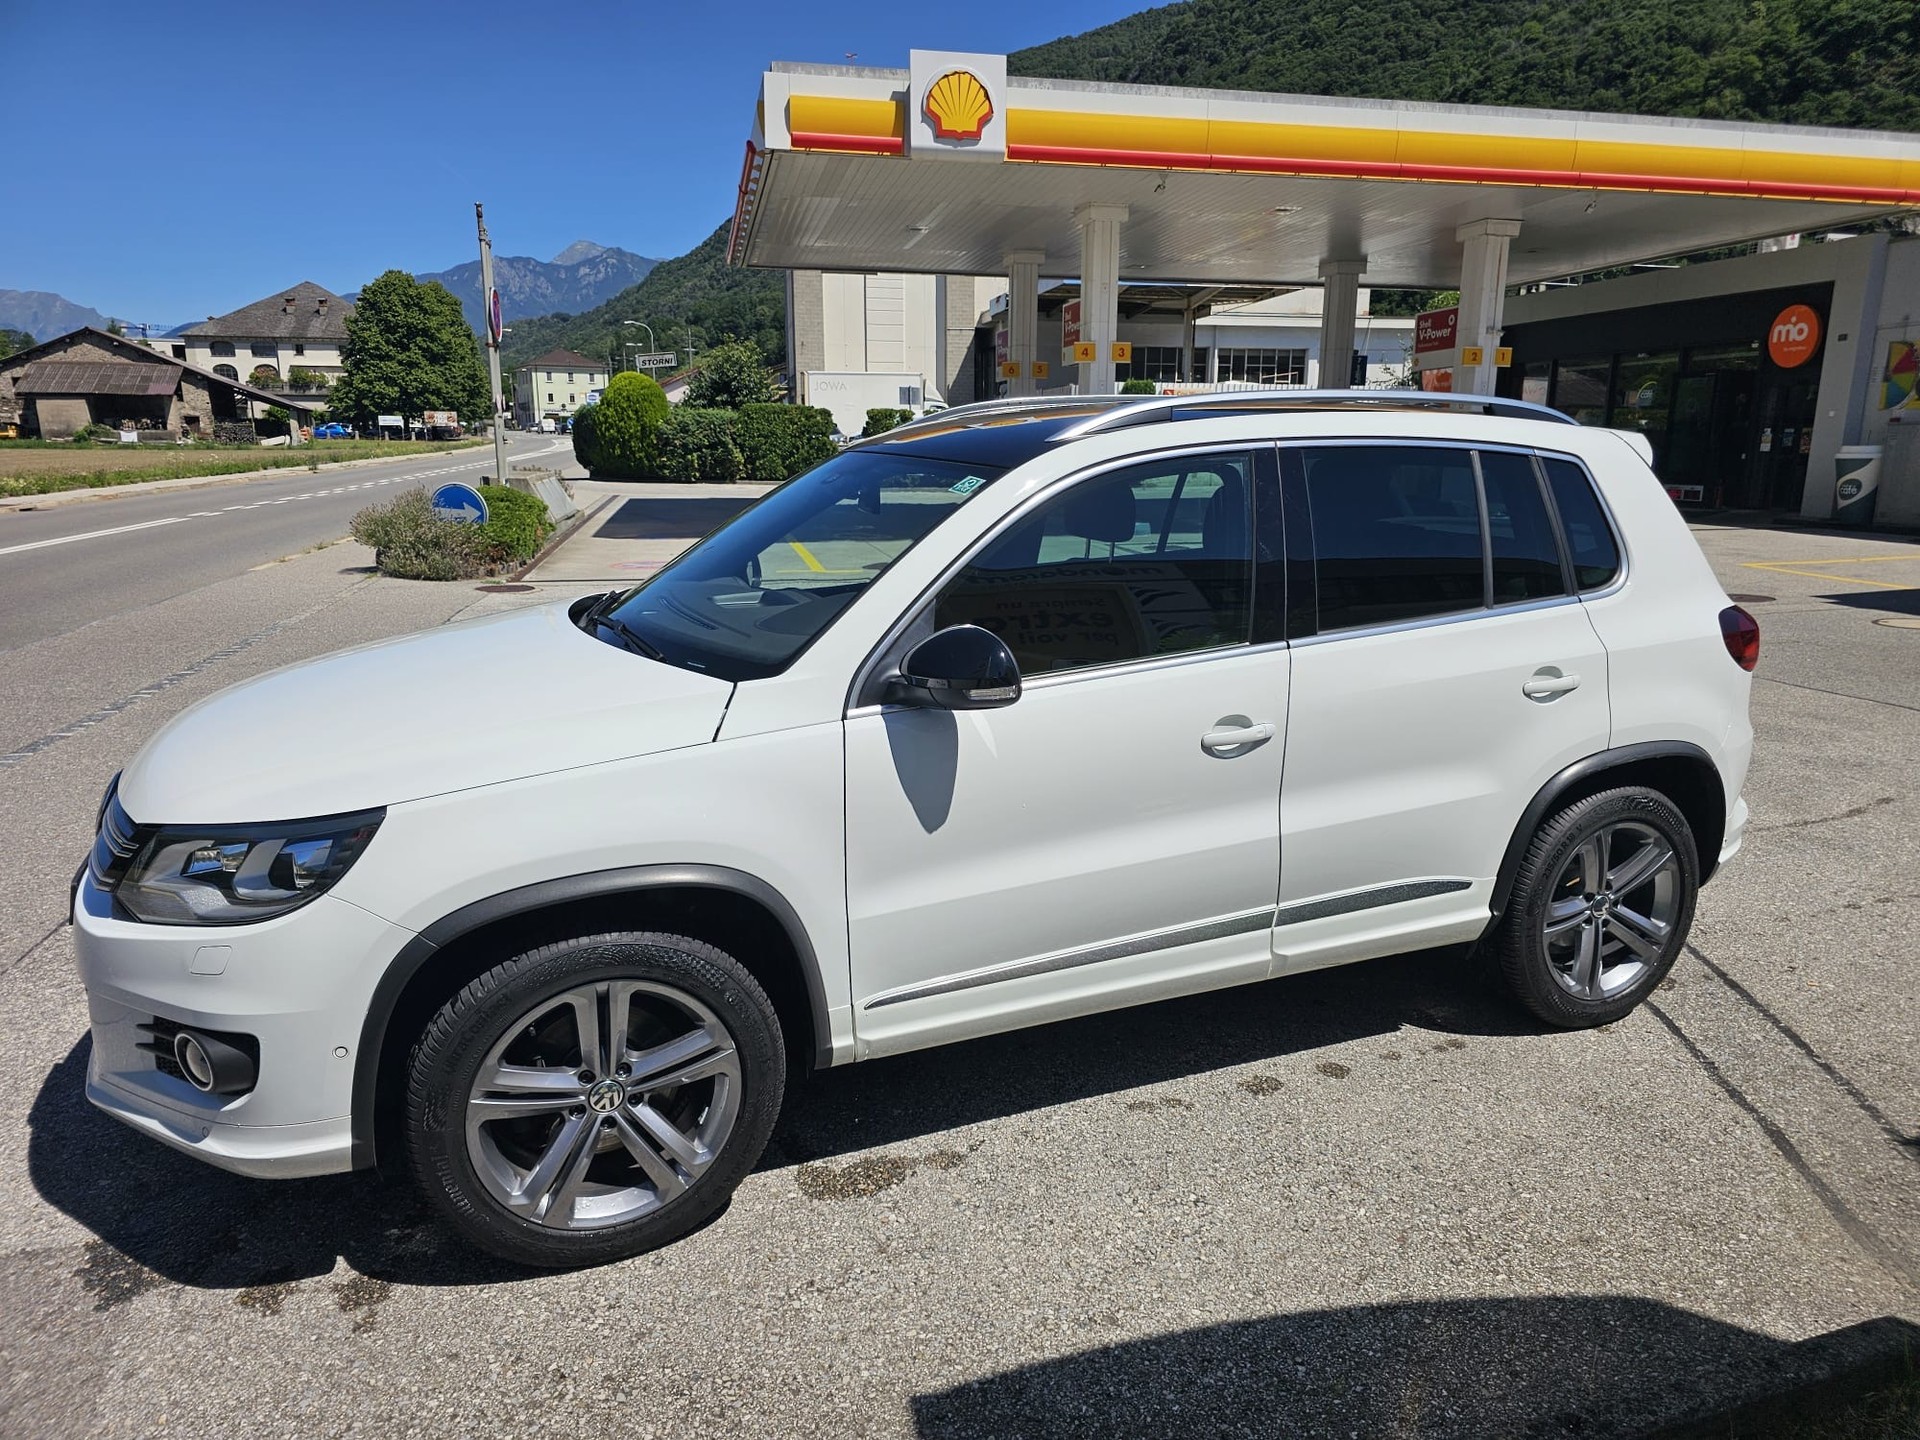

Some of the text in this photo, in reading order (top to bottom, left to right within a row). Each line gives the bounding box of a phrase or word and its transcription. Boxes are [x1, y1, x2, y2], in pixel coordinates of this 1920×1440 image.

[1419, 327, 1452, 341] V-Power
[1772, 316, 1809, 343] mio
[1081, 347, 1089, 357] 4
[1118, 347, 1125, 358] 3
[1471, 351, 1478, 361] 2
[1501, 351, 1506, 361] 1
[641, 357, 673, 367] STORNI
[1008, 365, 1015, 374] 6
[1036, 365, 1043, 374] 5
[814, 381, 848, 392] JOWA
